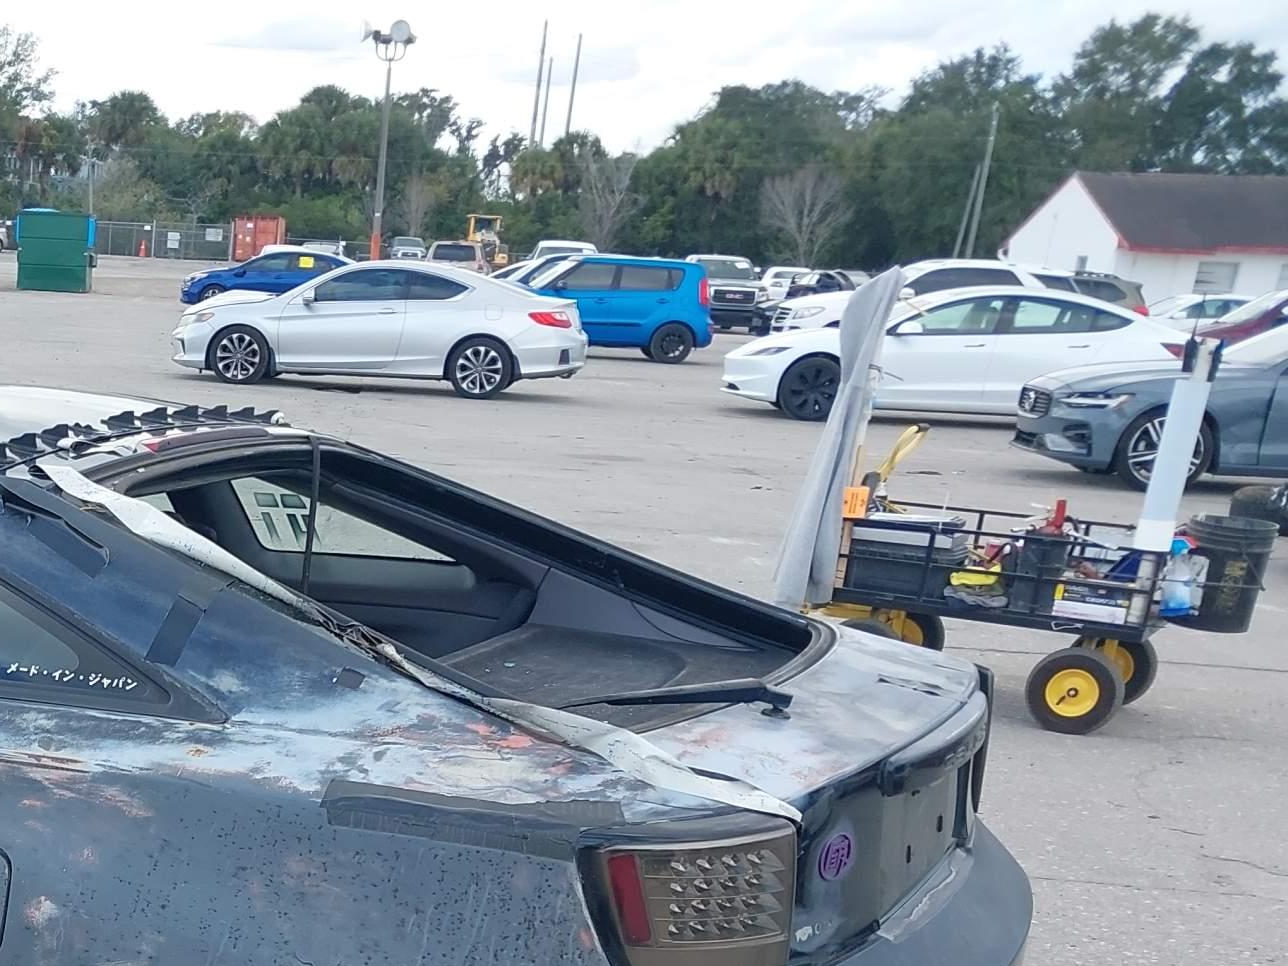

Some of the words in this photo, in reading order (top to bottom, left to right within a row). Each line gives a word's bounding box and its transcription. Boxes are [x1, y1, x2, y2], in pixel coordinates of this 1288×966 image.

[6, 662, 138, 690] メード・イン・ジャパン
